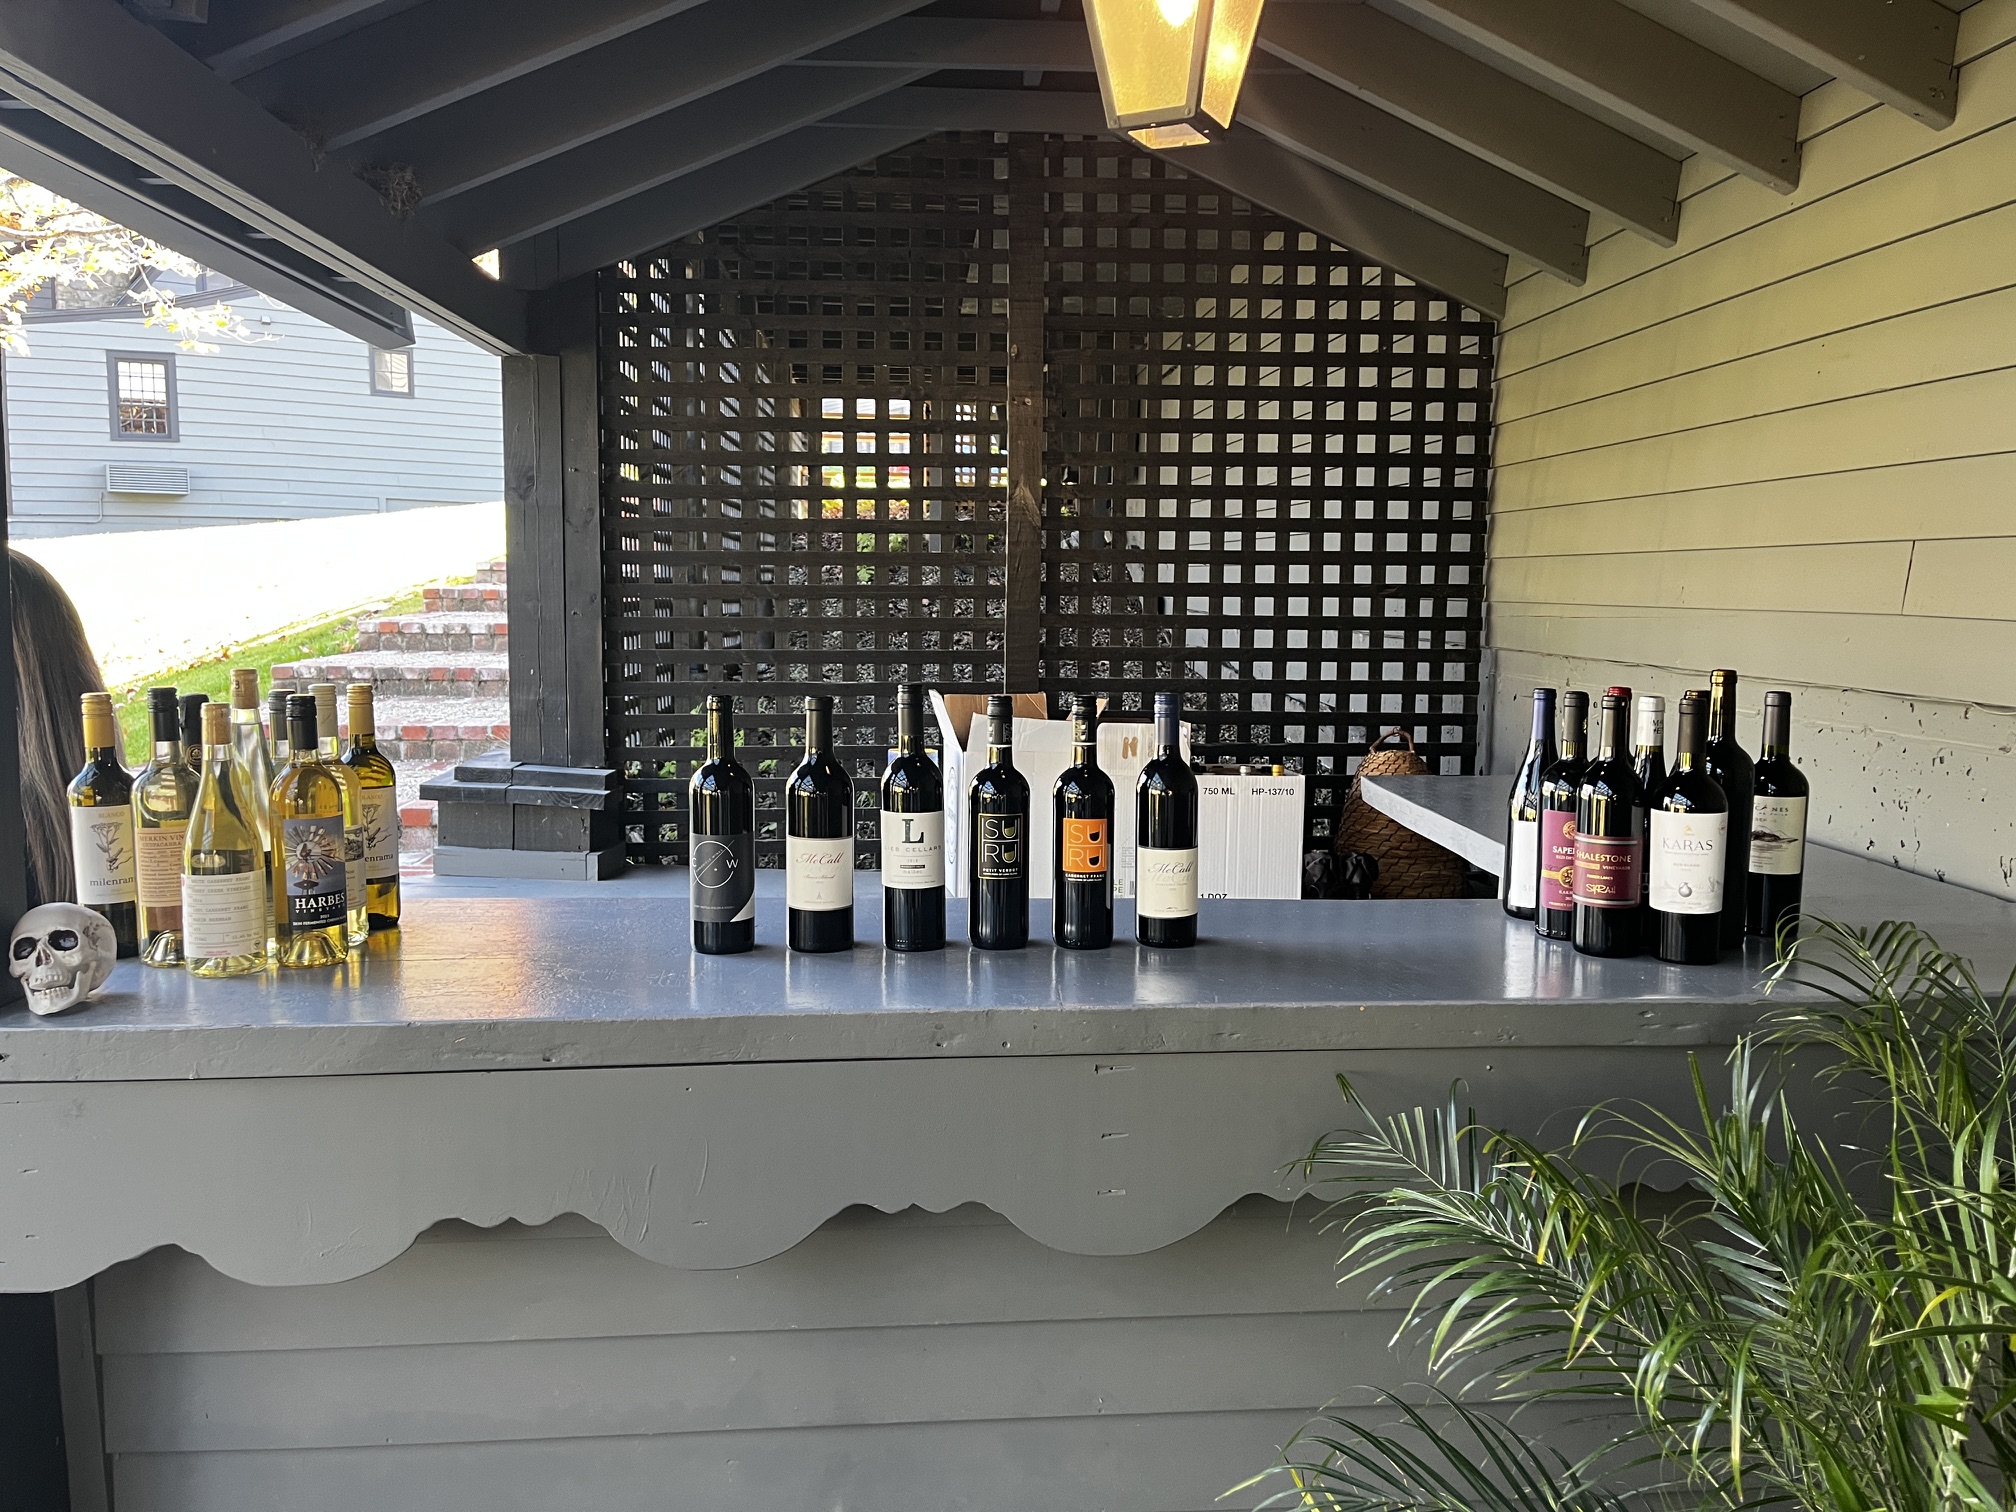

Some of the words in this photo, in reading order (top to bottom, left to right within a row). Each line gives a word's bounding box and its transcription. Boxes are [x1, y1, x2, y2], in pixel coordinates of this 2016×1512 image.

[1203, 787, 1219, 796] 750
[1221, 788, 1235, 796] ML
[1251, 788, 1295, 796] HP-137/10
[902, 818, 924, 844] L
[1662, 837, 1713, 852] KARAS
[364, 854, 394, 863] enrama
[795, 852, 844, 865] McCall
[1577, 850, 1632, 862] SHALESTONE
[692, 857, 698, 868] C
[726, 859, 739, 869] W
[1148, 861, 1194, 874] McCall
[294, 892, 345, 909] HARBES
